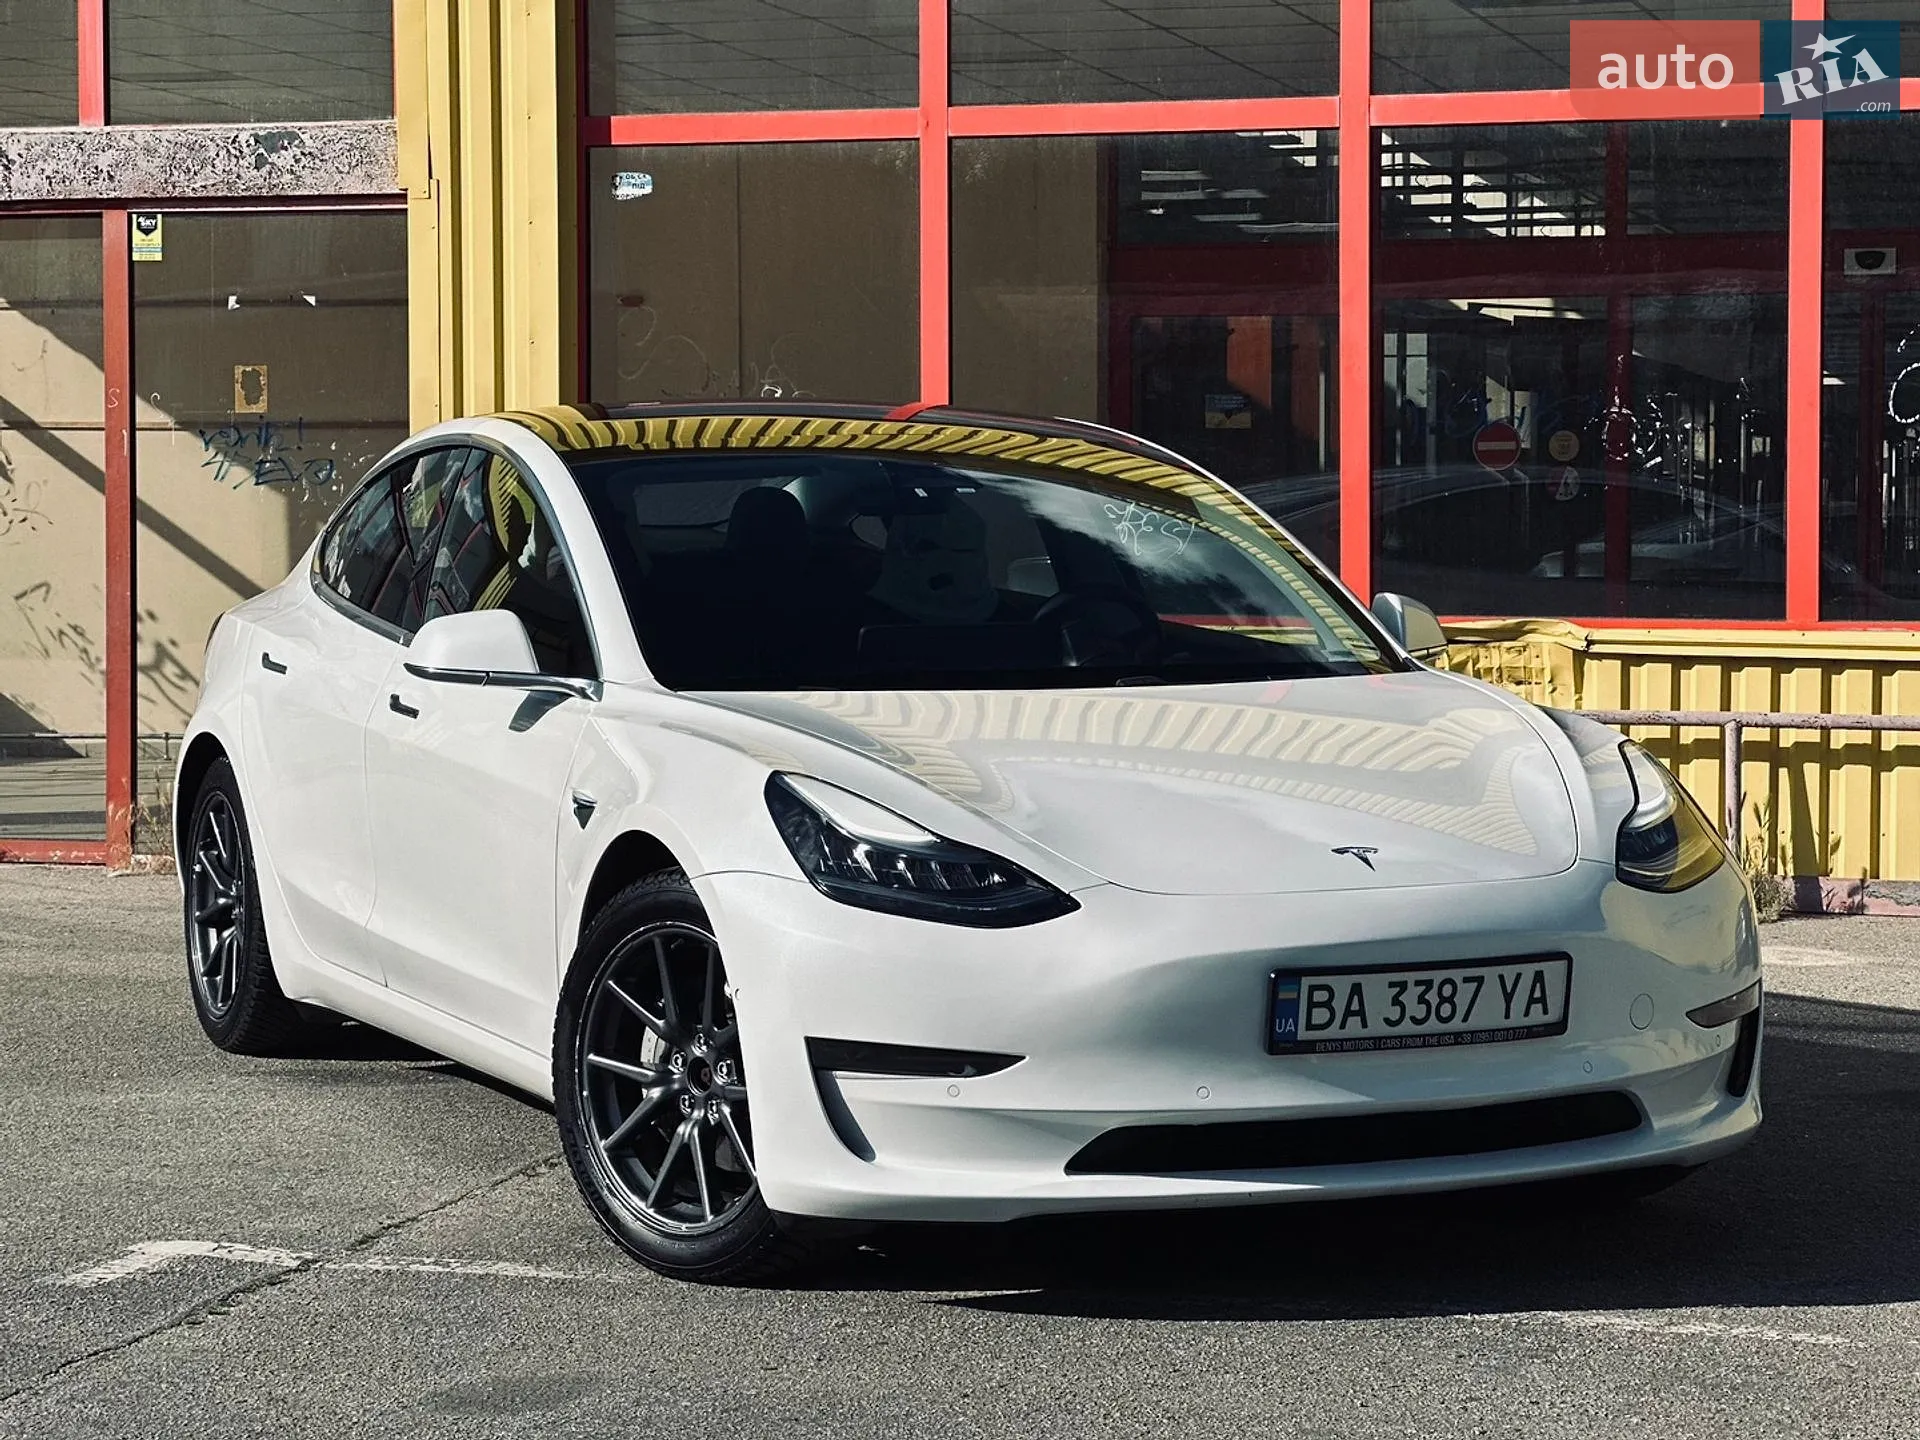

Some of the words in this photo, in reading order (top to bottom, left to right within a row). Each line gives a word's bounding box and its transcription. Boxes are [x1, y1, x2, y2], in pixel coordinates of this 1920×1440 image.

[1305, 982, 1368, 1032] BA
[1383, 975, 1485, 1028] 3387
[1498, 970, 1549, 1020] YA
[1275, 1018, 1296, 1033] UA
[1315, 1040, 1341, 1052] DENYS
[1343, 1039, 1374, 1050] MOTORS
[1380, 1038, 1400, 1049] CARS
[1402, 1037, 1423, 1048] FROM
[1425, 1035, 1439, 1046] THE
[1440, 1035, 1455, 1045] USA
[1457, 1033, 1472, 1043] +38
